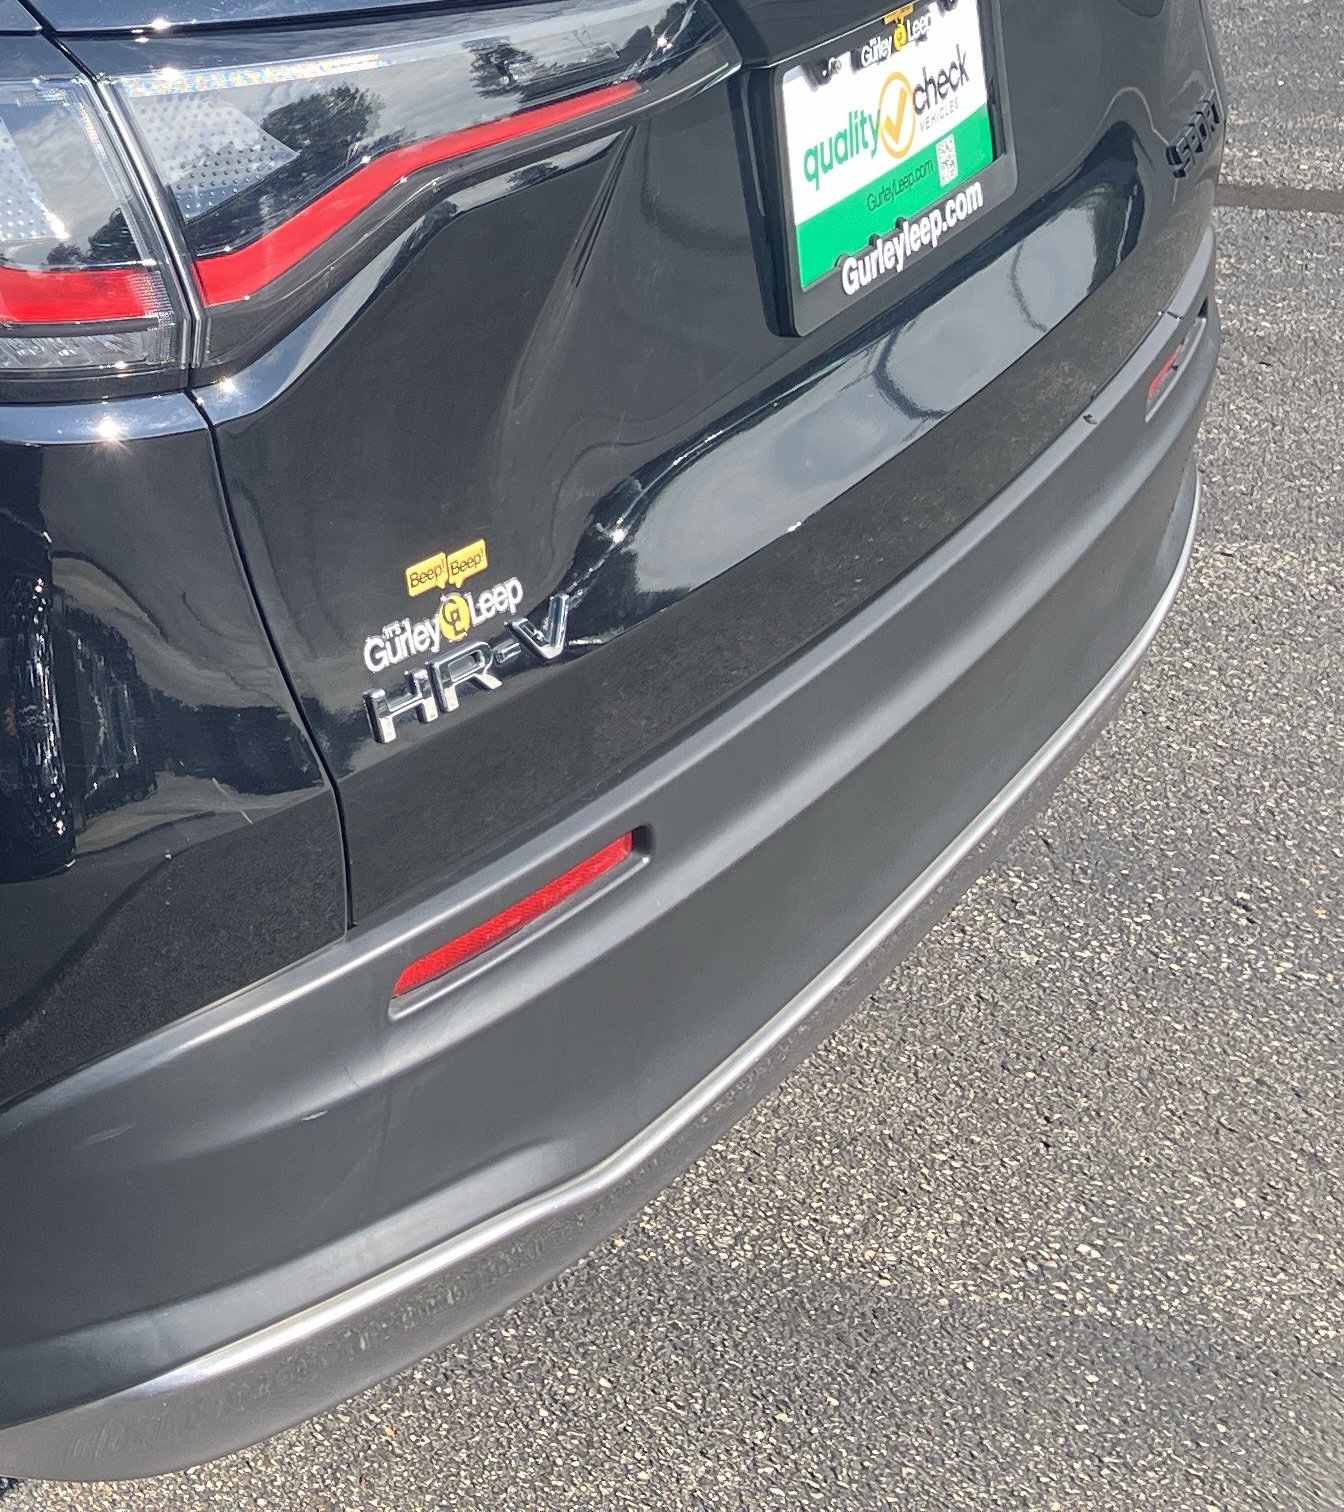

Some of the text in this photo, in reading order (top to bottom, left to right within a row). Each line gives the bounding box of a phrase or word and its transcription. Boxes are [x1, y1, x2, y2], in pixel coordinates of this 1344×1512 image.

[912, 44, 970, 115] check
[804, 109, 881, 190] quality
[842, 181, 984, 296] Gurleyleep.com
[409, 548, 484, 589] Beep! Beep!
[362, 593, 570, 744] HR-V
[363, 616, 441, 673] Gurley
[466, 576, 523, 627] Leep
